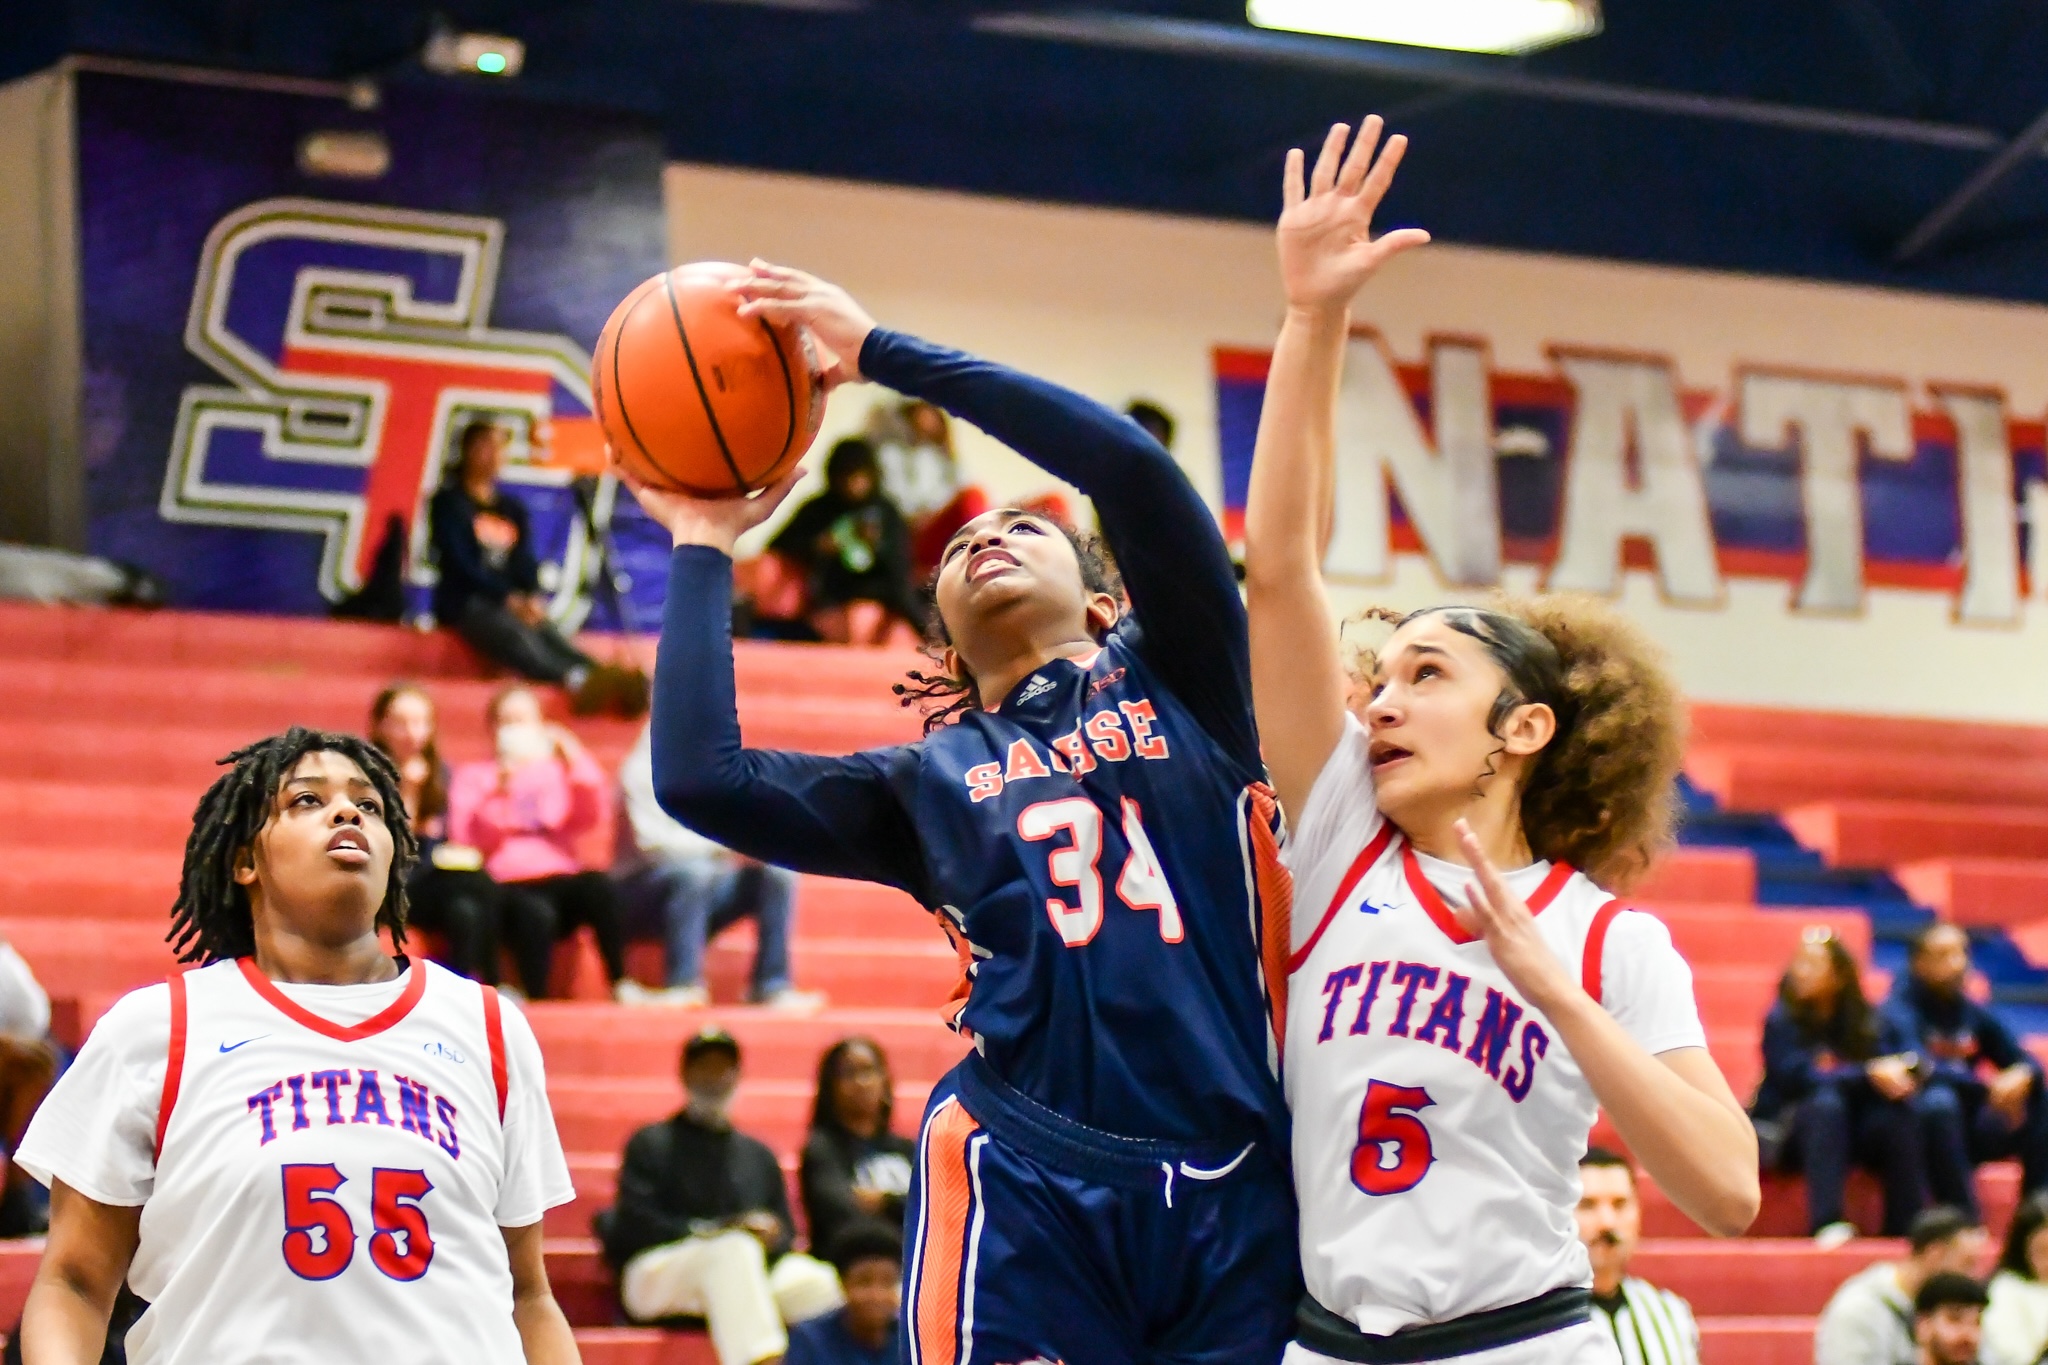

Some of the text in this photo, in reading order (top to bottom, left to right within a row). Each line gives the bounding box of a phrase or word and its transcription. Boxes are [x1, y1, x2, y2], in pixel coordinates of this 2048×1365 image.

[1017, 795, 1185, 948] 34
[1317, 960, 1550, 1104] TITANS
[247, 1068, 461, 1161] TITANS
[1350, 1078, 1438, 1197] 5
[280, 1162, 437, 1283] 55
